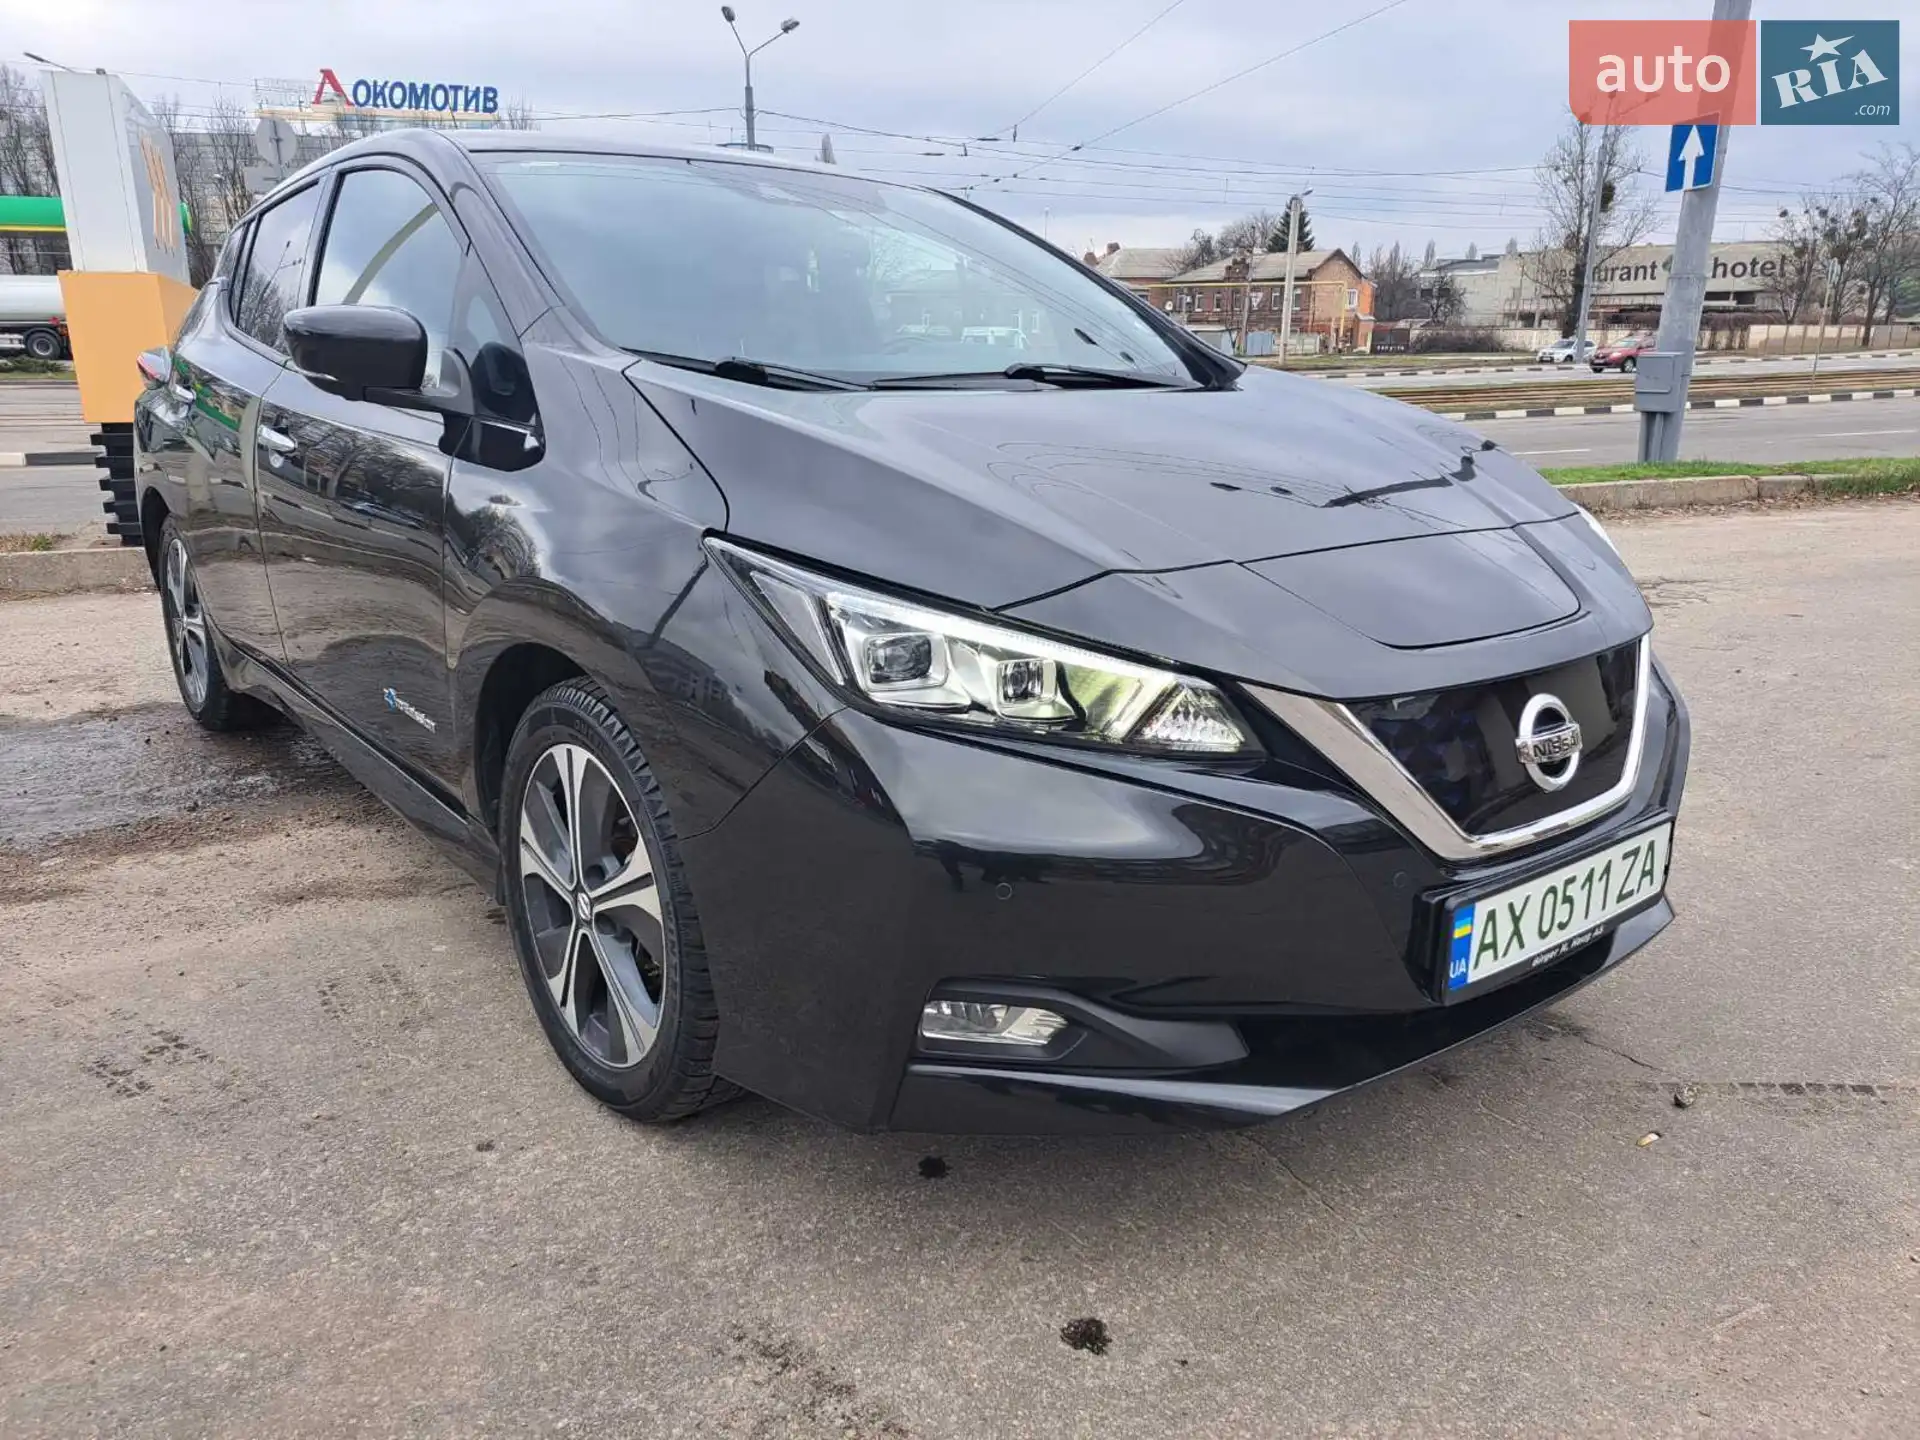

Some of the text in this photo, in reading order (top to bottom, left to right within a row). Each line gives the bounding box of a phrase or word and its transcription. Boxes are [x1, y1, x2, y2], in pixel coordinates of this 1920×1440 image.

[1711, 254, 1787, 279] hotel
[1473, 840, 1656, 970] AX 0511 ZA
[1449, 960, 1467, 979] UA
